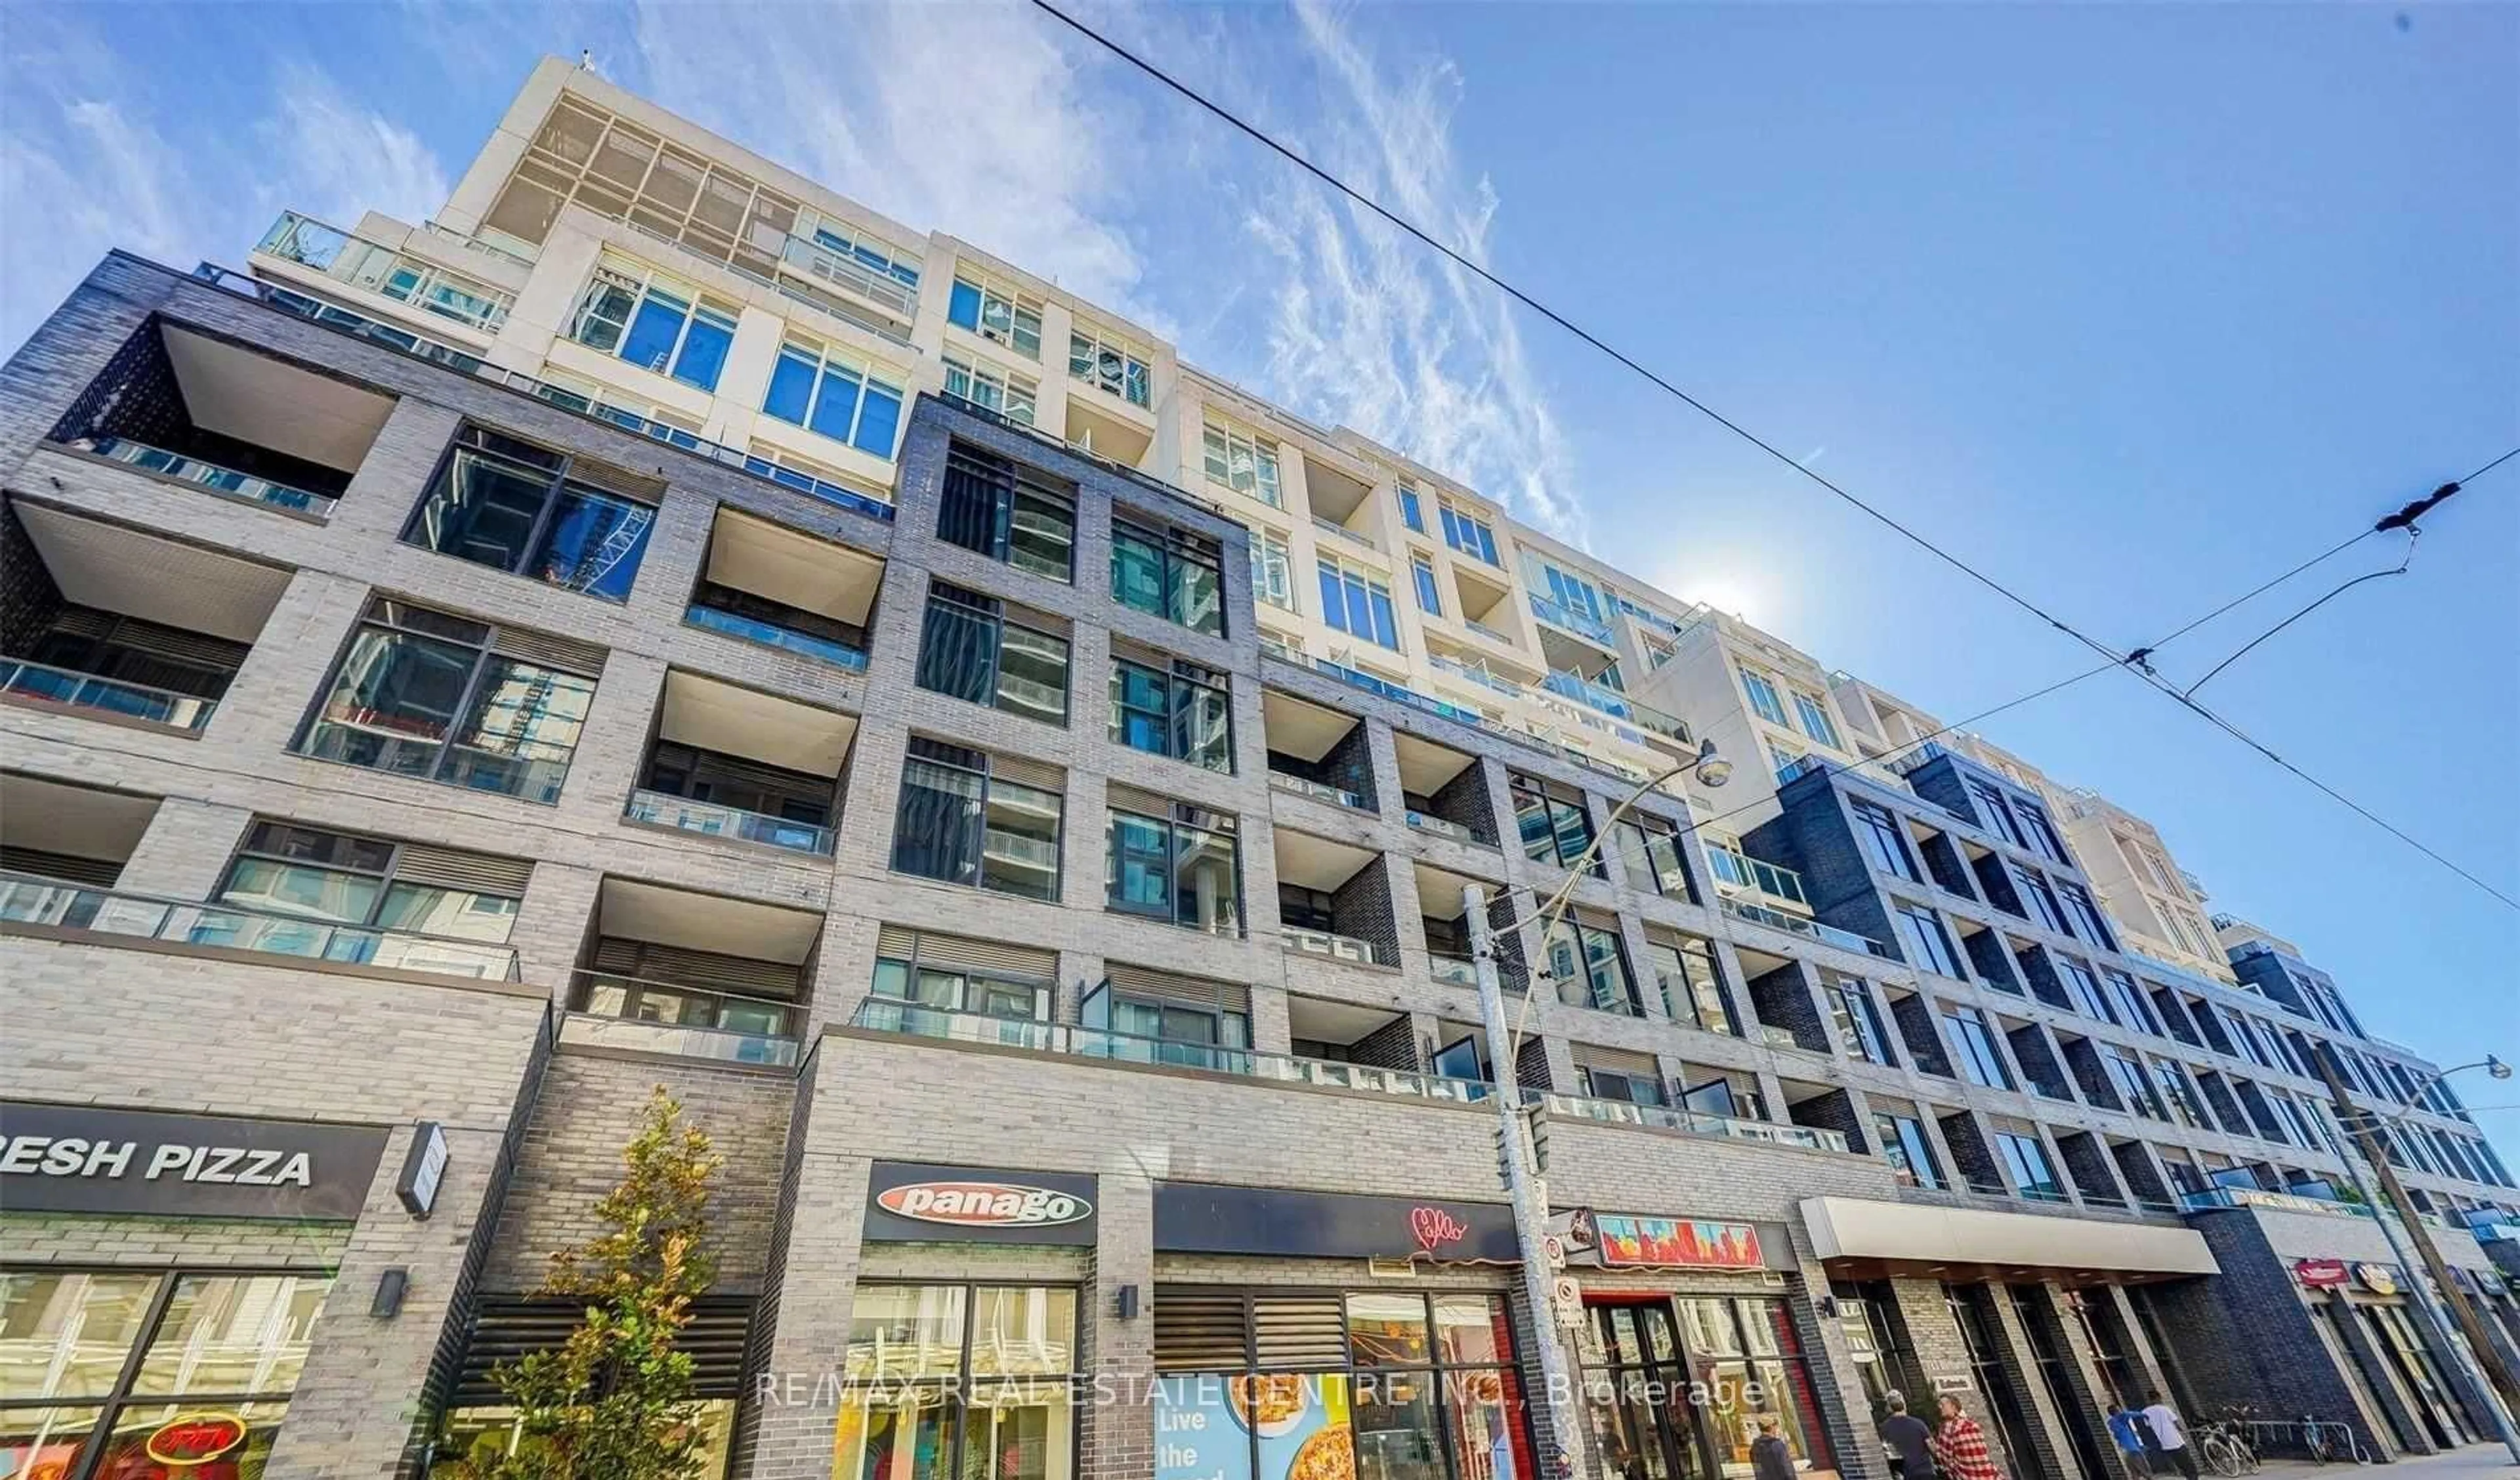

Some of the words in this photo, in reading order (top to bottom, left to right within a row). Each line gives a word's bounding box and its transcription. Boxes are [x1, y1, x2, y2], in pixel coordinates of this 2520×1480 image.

[0, 1135, 136, 1178] ESH
[144, 1143, 311, 1187] PIZZA
[900, 1187, 1076, 1221] panago
[1160, 1408, 1206, 1431] Live
[1160, 1443, 1198, 1468] the
